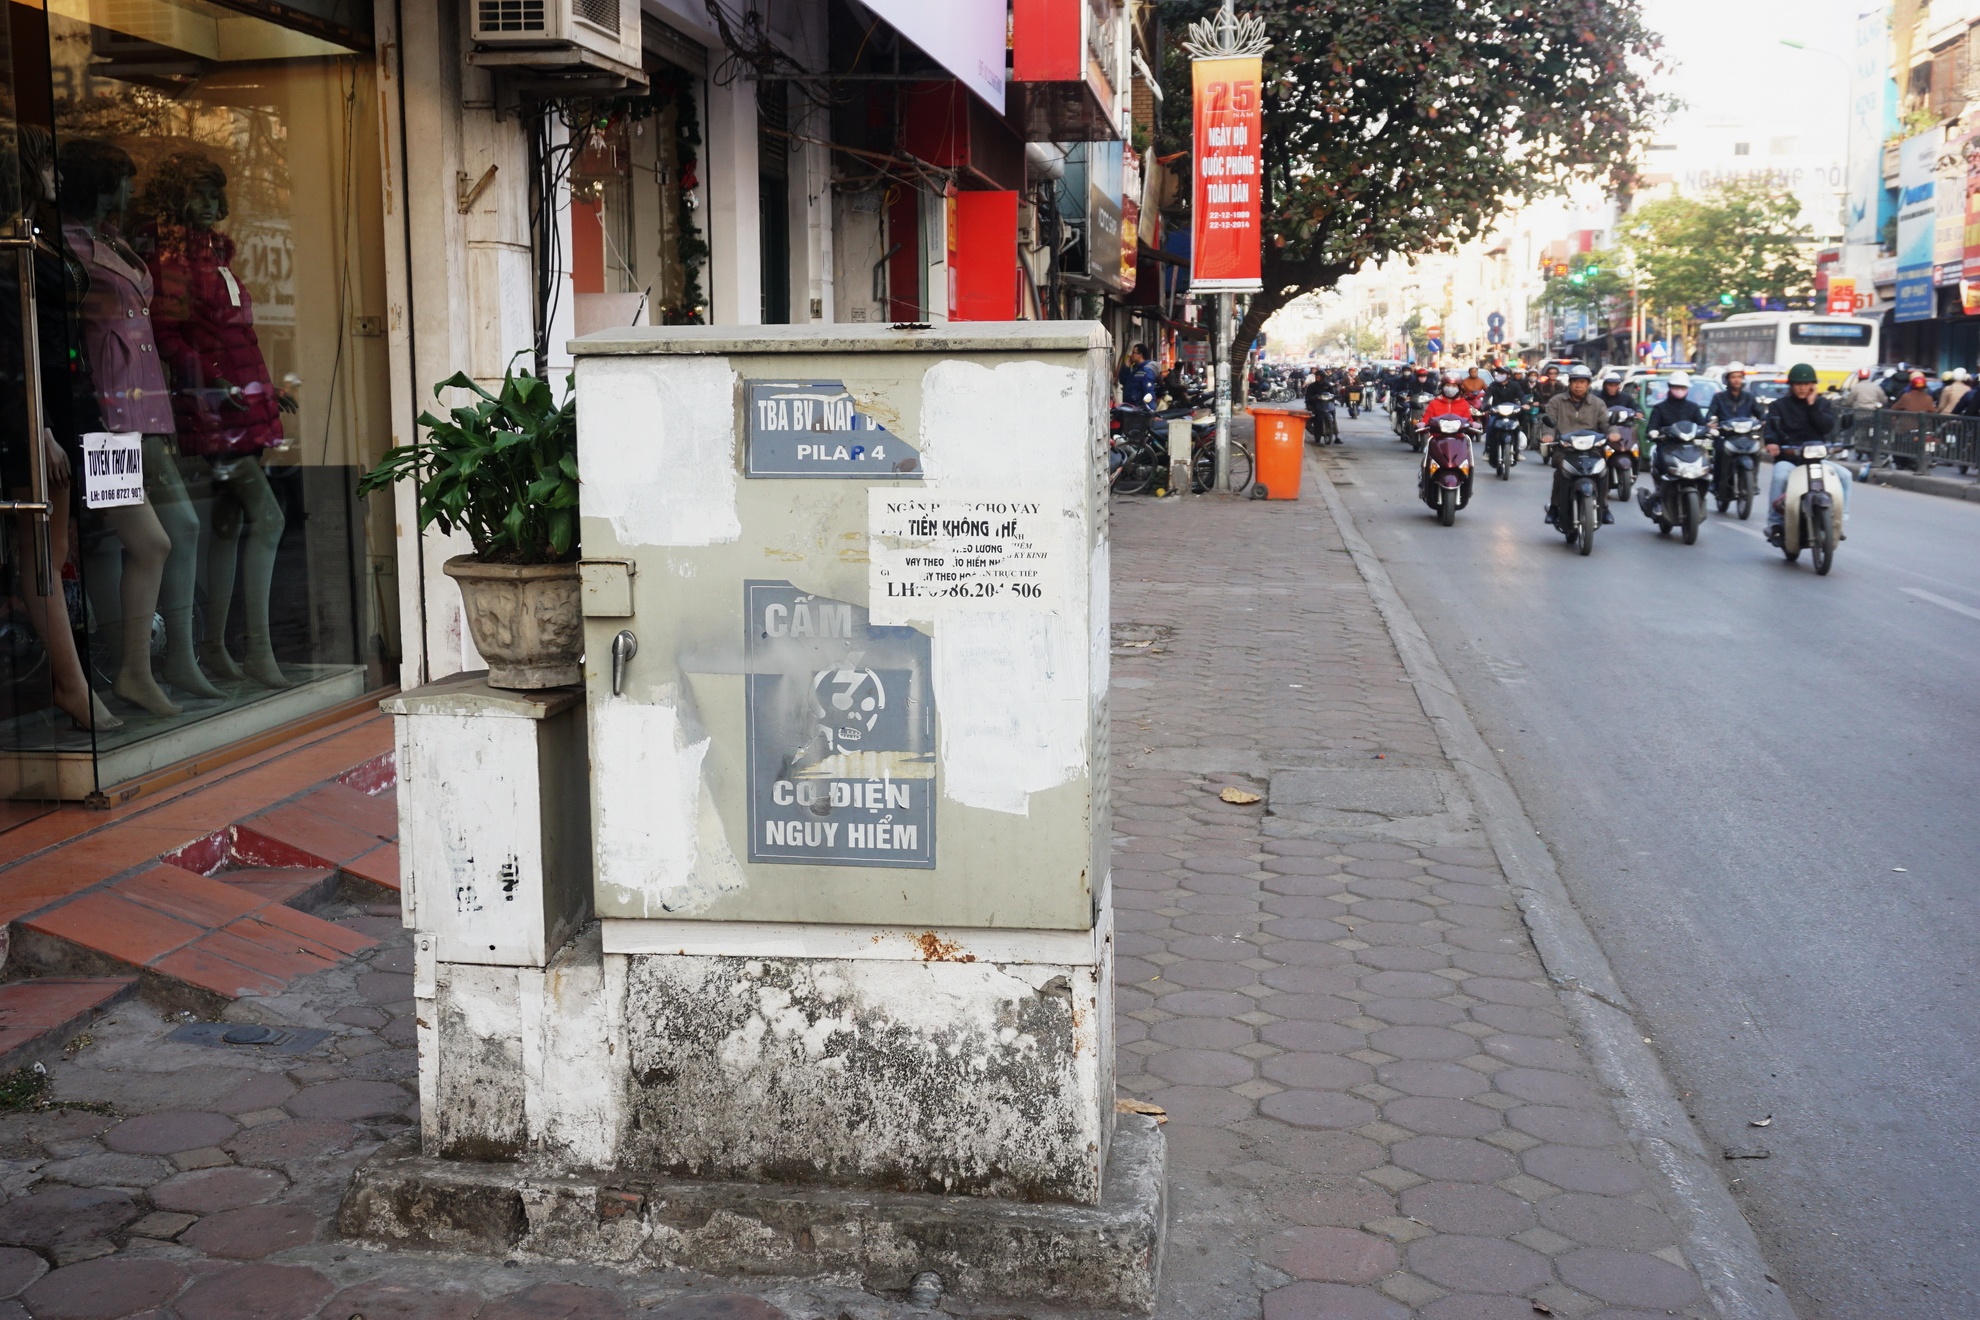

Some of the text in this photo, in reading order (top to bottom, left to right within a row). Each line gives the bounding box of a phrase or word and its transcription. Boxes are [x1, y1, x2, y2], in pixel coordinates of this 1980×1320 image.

[1206, 80, 1255, 112] 25
[1208, 121, 1248, 150] NGÀY HỘI
[1202, 149, 1254, 178] QUỐC PHÒNG
[1207, 179, 1249, 203] TOÀN DÂN
[758, 400, 789, 431] TBA
[126, 448, 140, 474] MAY
[797, 444, 886, 461] PILAR 4
[101, 489, 115, 501] 0166
[116, 488, 130, 500] 8727
[1010, 503, 1041, 514] VAY
[908, 513, 938, 536] TIỀN
[942, 516, 989, 538] KHÔNG
[923, 558, 945, 567] THEO
[935, 572, 957, 581] THEO
[765, 594, 851, 639] CẤM
[766, 814, 918, 850] NGUY HIỂM
